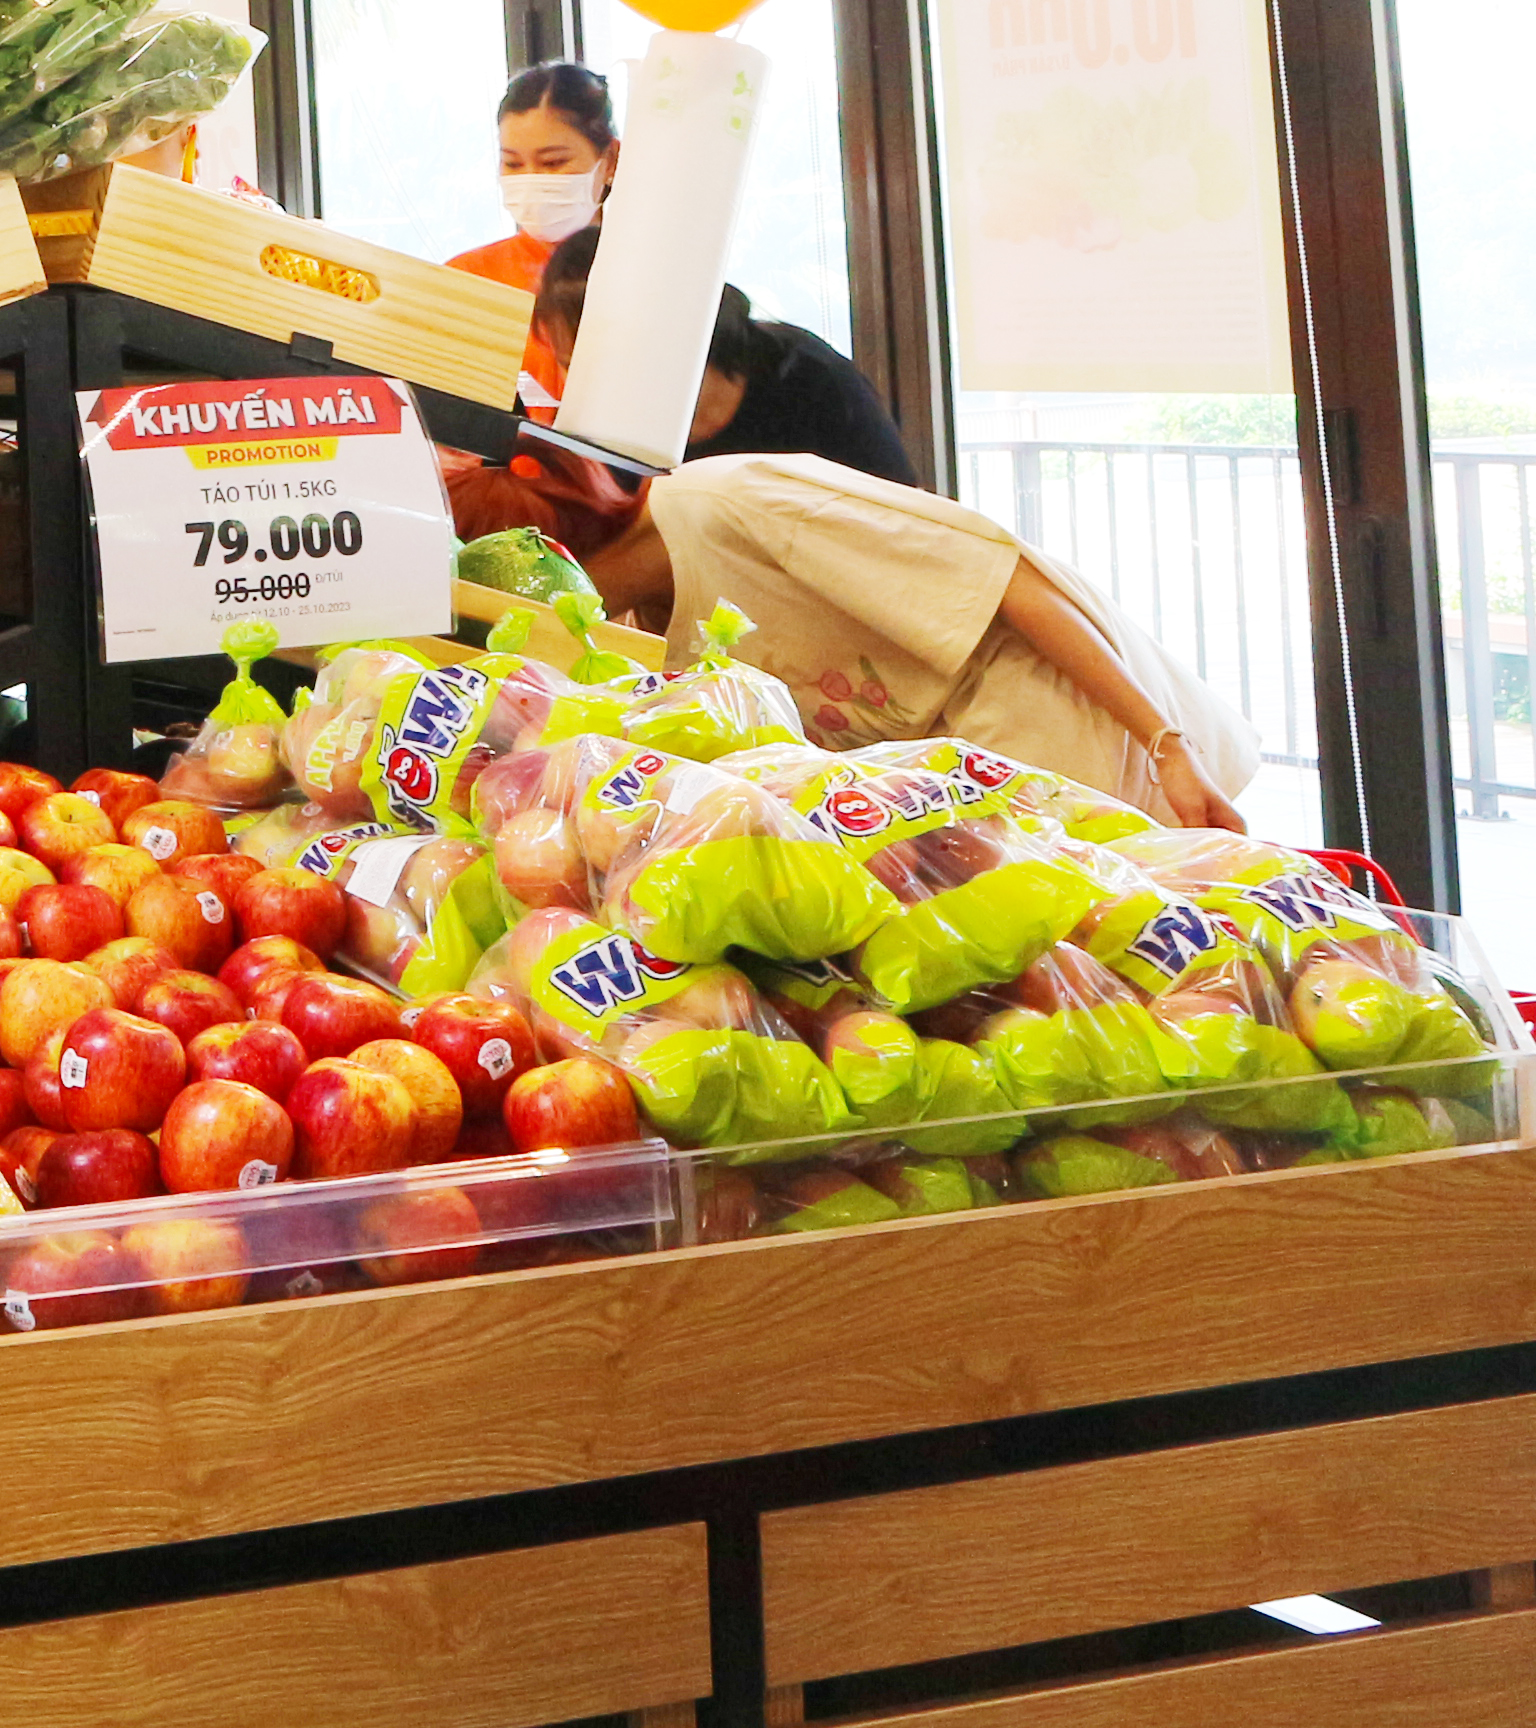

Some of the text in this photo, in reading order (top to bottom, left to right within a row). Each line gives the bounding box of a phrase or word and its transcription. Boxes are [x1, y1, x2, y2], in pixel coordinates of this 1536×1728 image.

[131, 387, 377, 437] KHUYẾN MÃI
[206, 443, 322, 464] PROMOTION
[200, 479, 338, 505] TÁO TÚI 1.5KG
[184, 510, 363, 568] 79.000
[215, 572, 311, 604] 95.000
